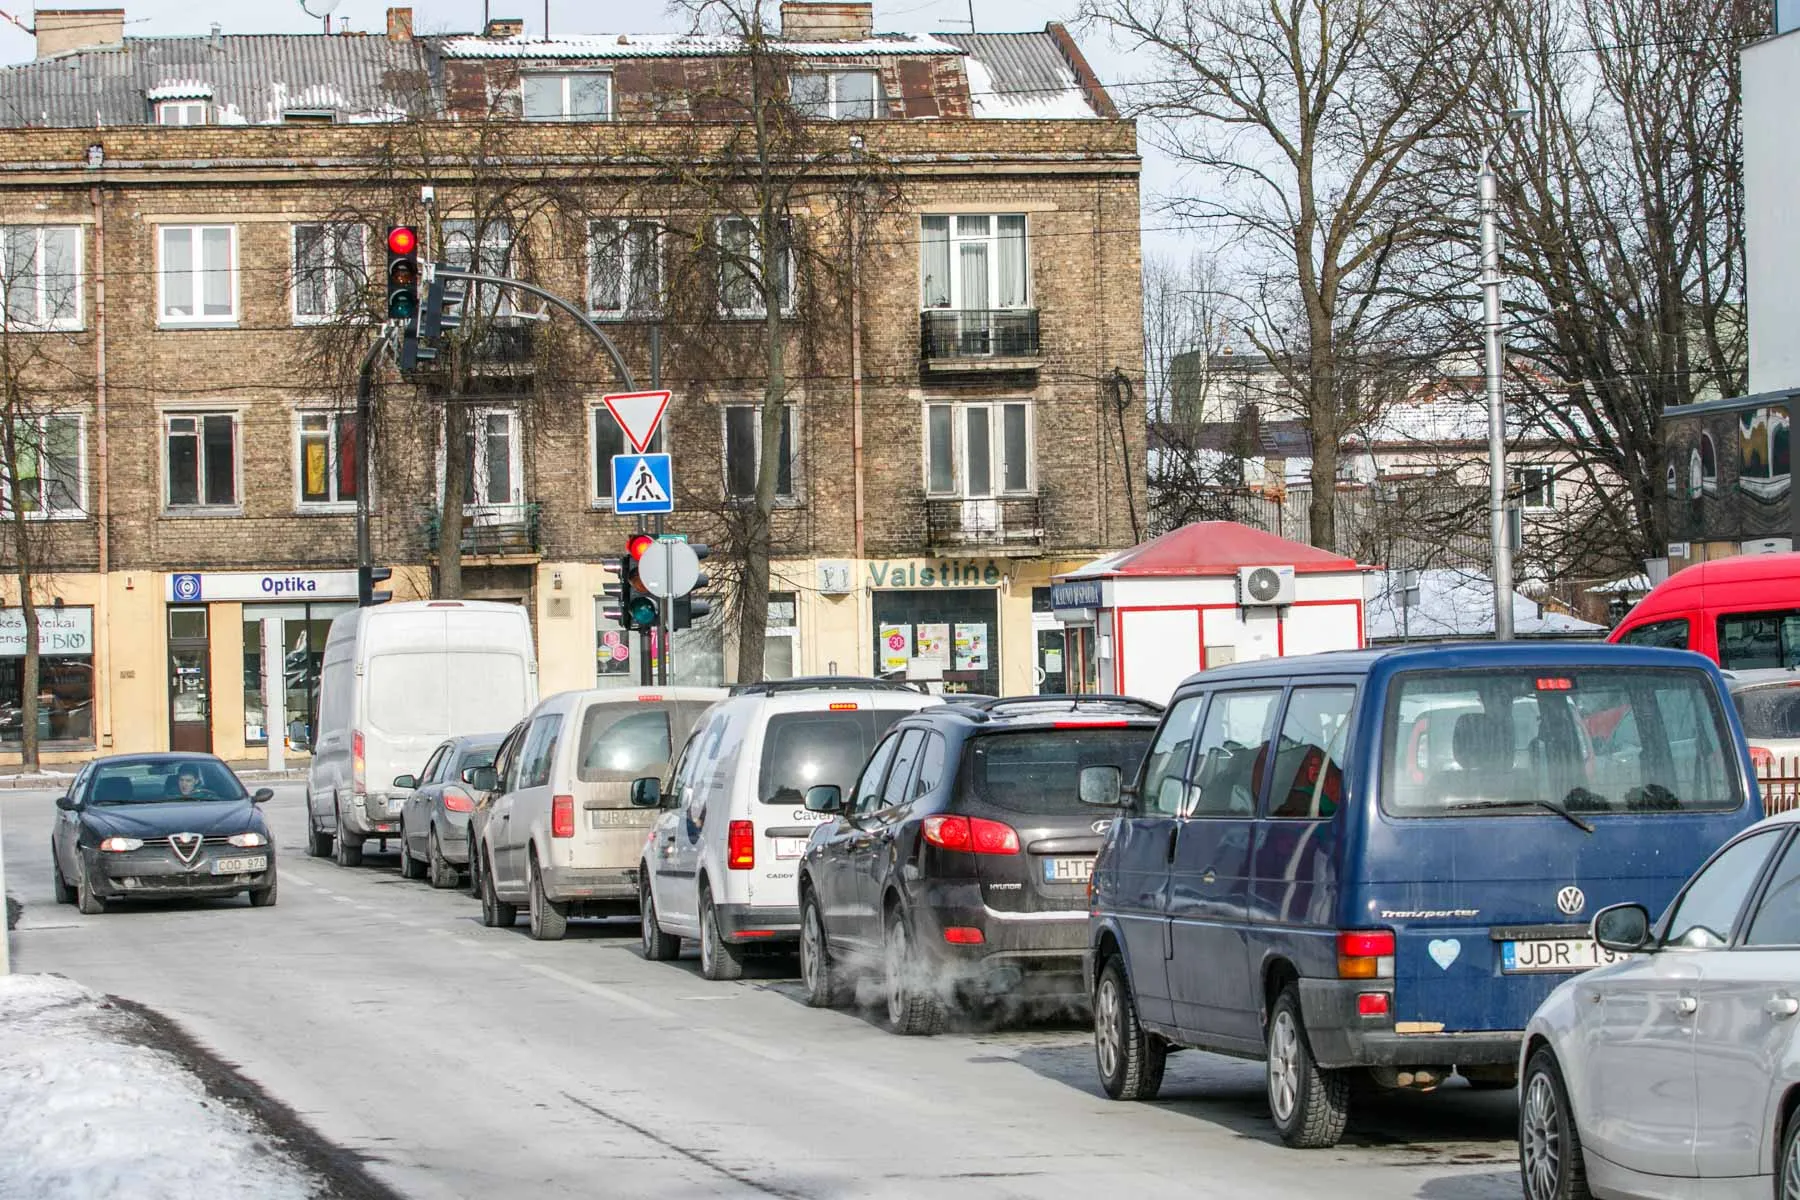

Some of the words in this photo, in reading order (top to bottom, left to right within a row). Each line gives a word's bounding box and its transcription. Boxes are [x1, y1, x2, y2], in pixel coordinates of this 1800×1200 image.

[261, 577, 317, 595] Optika
[38, 614, 75, 628] veikai
[1381, 909, 1480, 919] Transporter
[1520, 942, 1570, 965] JDR
